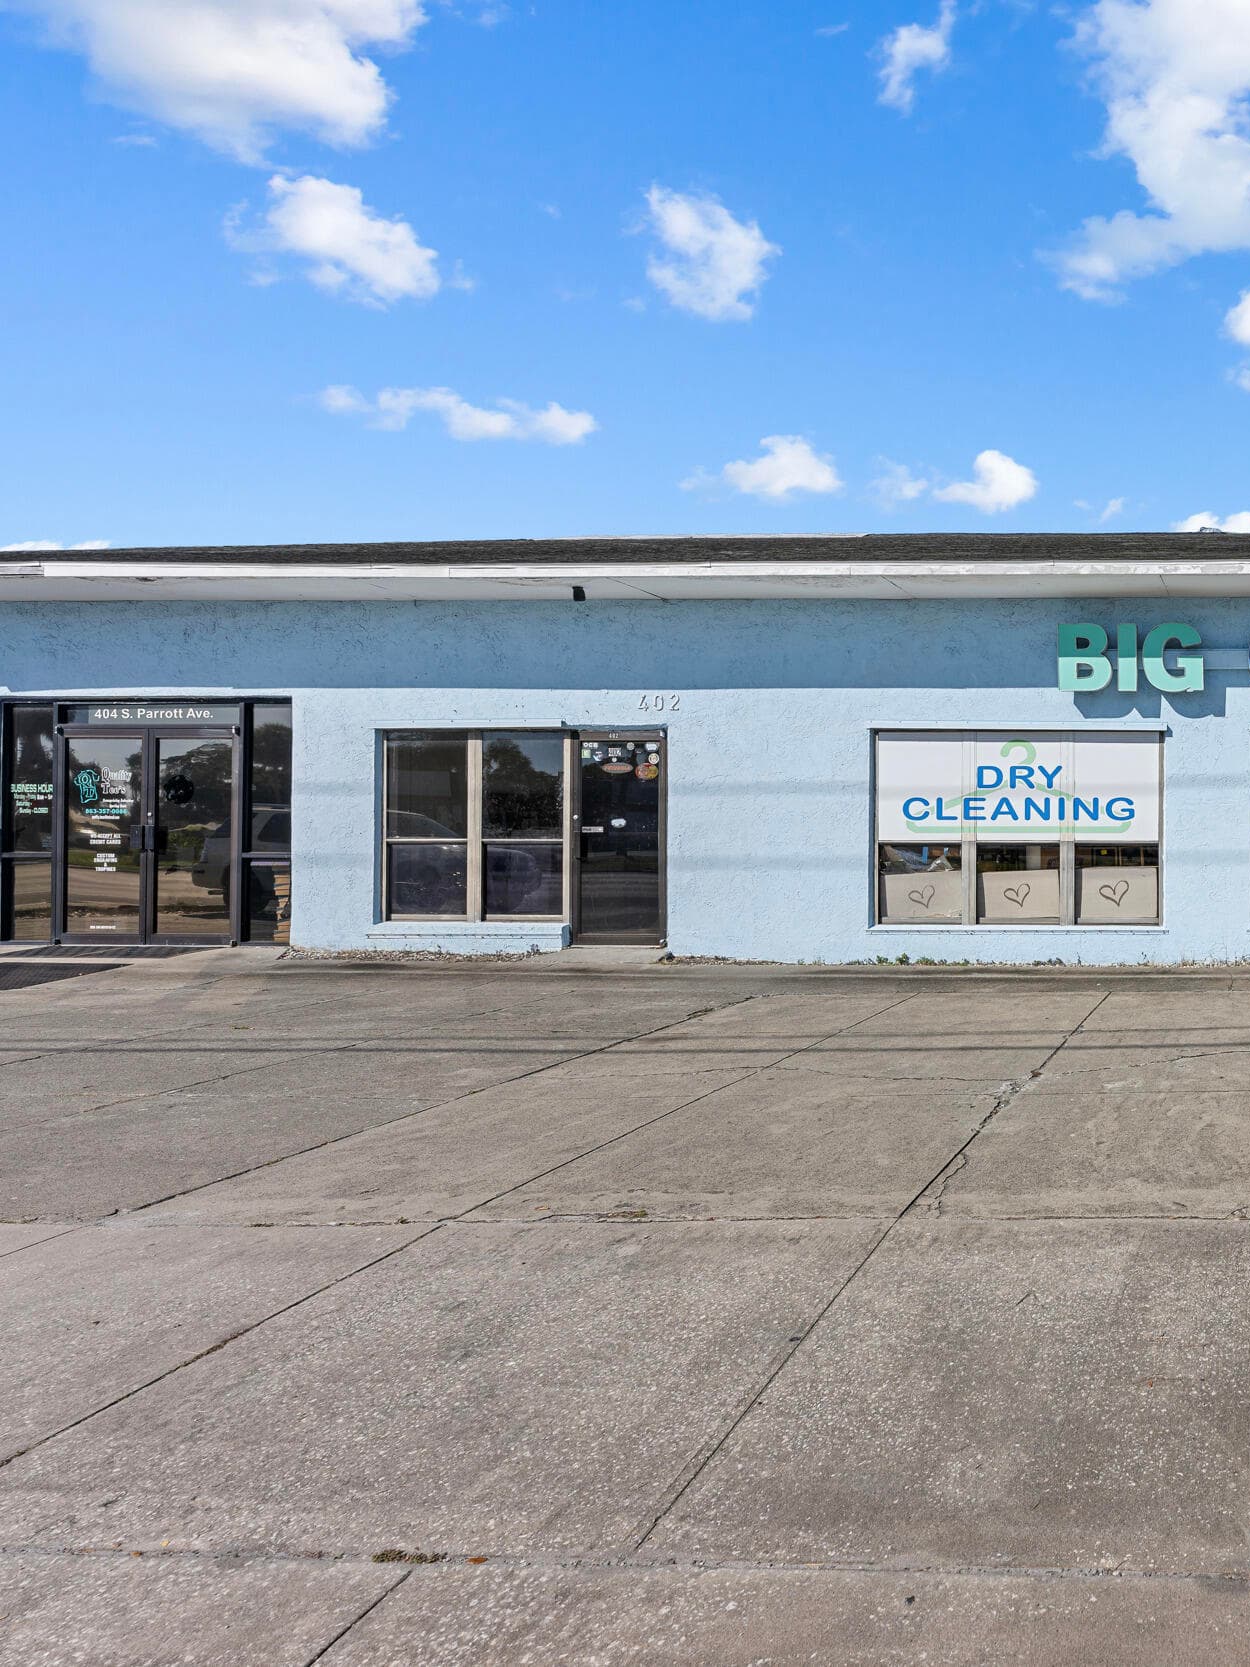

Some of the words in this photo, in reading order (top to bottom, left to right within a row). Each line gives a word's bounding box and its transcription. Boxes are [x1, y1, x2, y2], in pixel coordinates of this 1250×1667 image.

[1057, 622, 1204, 693] BIG
[638, 694, 680, 711] 402
[94, 708, 118, 719] 404
[121, 708, 133, 719] S.
[137, 708, 183, 719] Parrott
[186, 708, 214, 719] Ave.
[976, 765, 1063, 790] DRY
[11, 783, 37, 793] BUSINESS
[902, 797, 1136, 821] CLEANING
